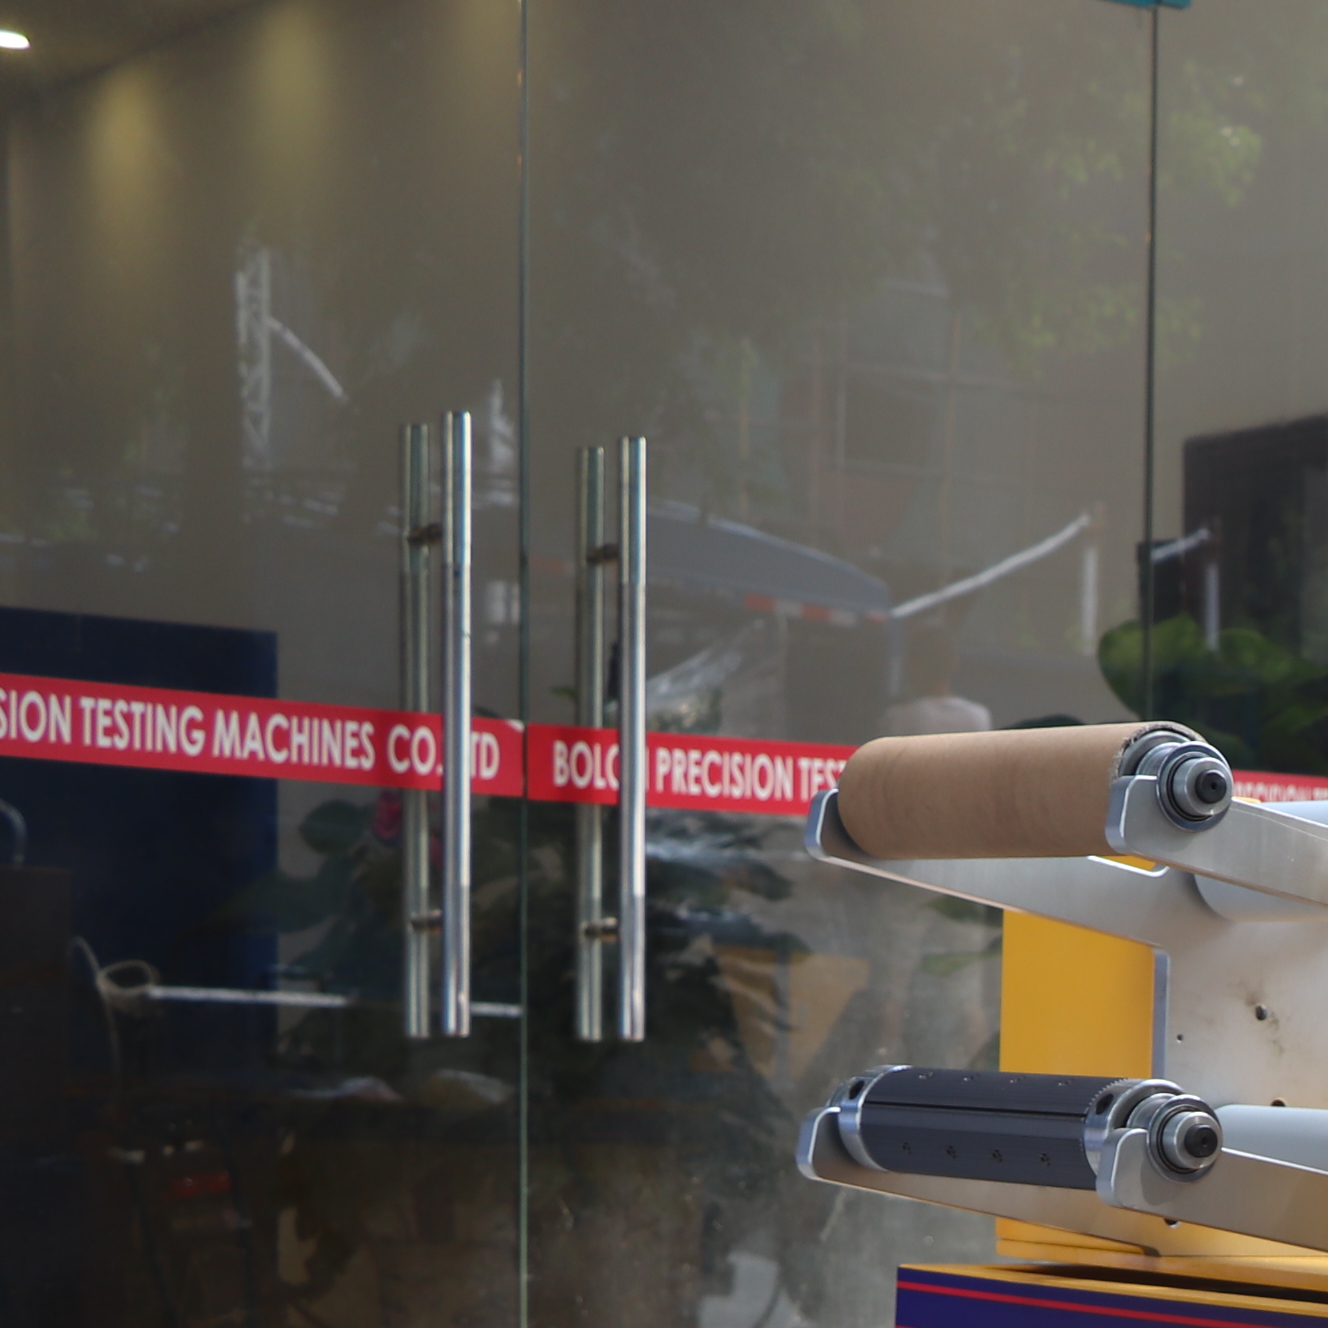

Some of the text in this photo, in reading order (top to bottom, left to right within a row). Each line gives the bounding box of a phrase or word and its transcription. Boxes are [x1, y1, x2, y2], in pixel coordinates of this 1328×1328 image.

[80, 696, 206, 757] TESTING
[212, 708, 376, 771] MACHINES
[655, 748, 794, 801] PRECISION
